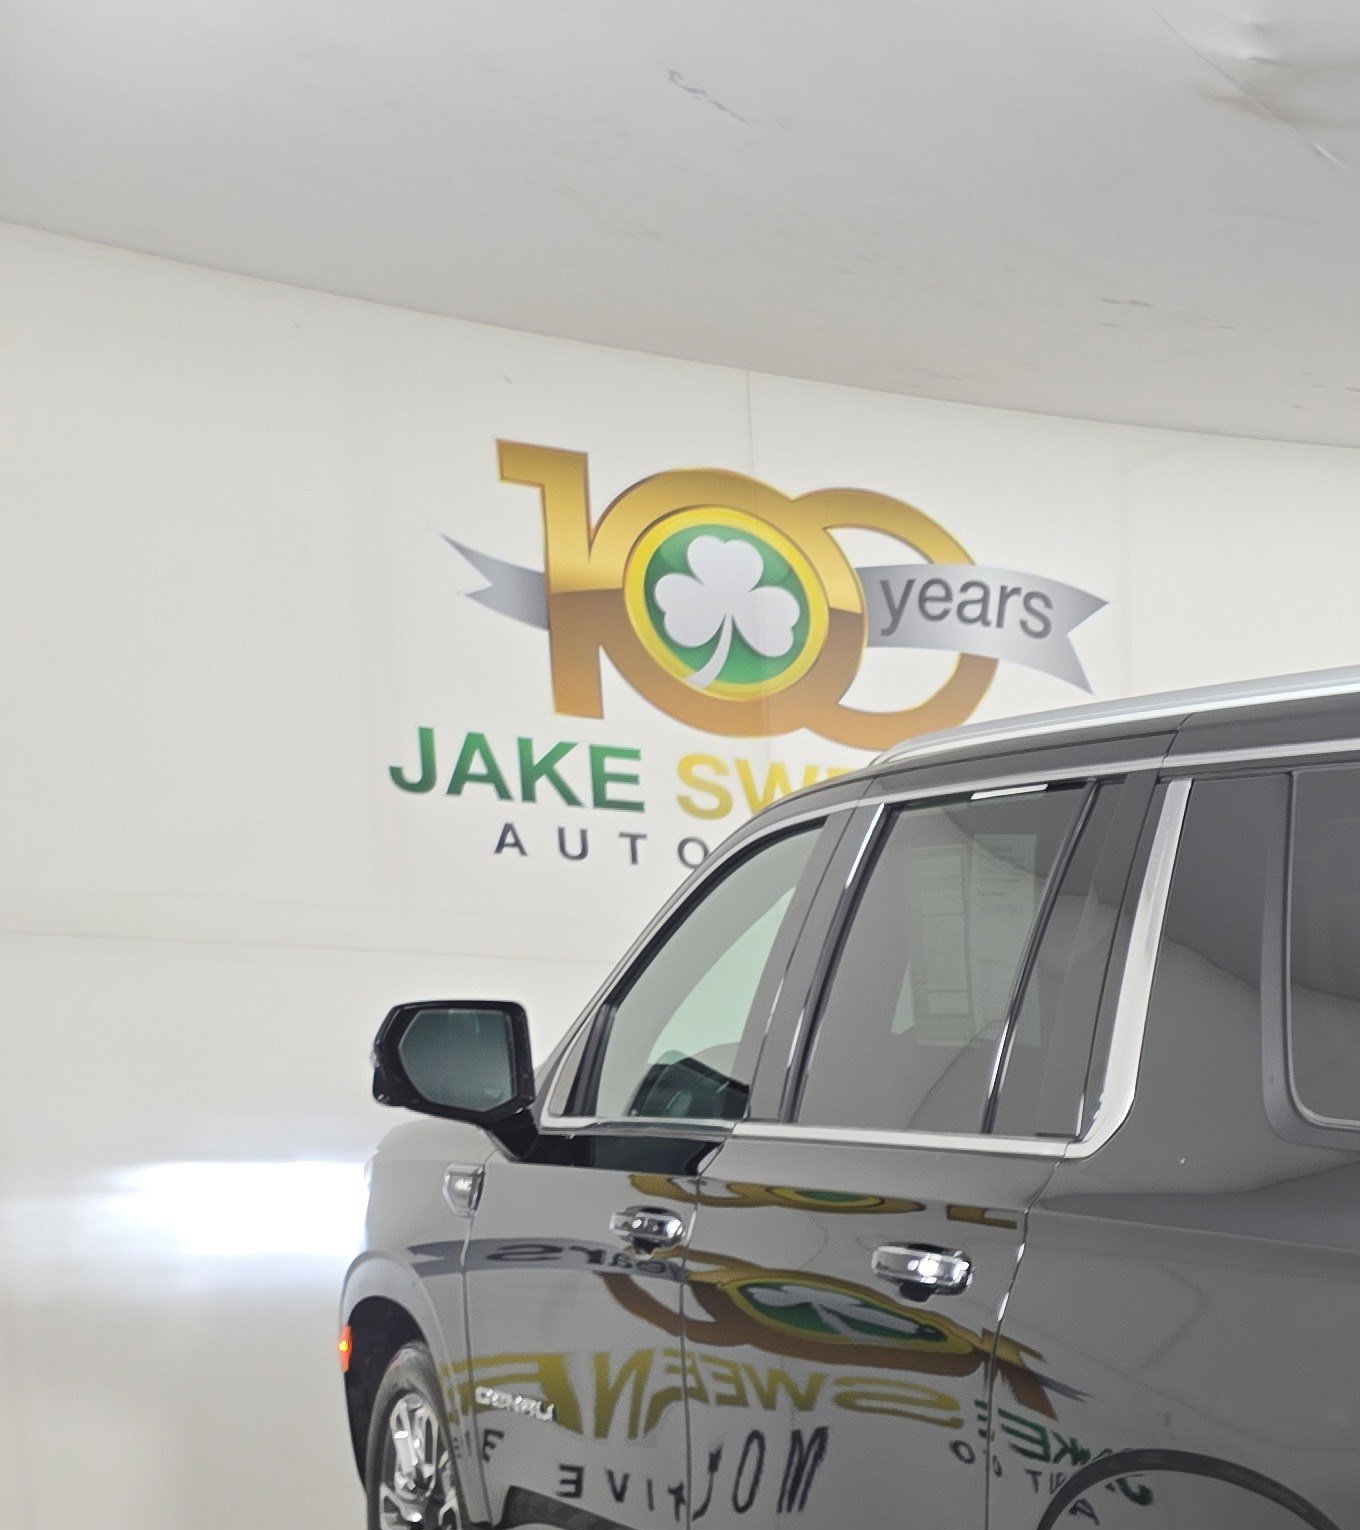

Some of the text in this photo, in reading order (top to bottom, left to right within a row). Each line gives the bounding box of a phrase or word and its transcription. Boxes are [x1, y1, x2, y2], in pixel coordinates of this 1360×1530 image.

[878, 573, 1055, 641] years
[388, 726, 858, 821] JAKE SW
